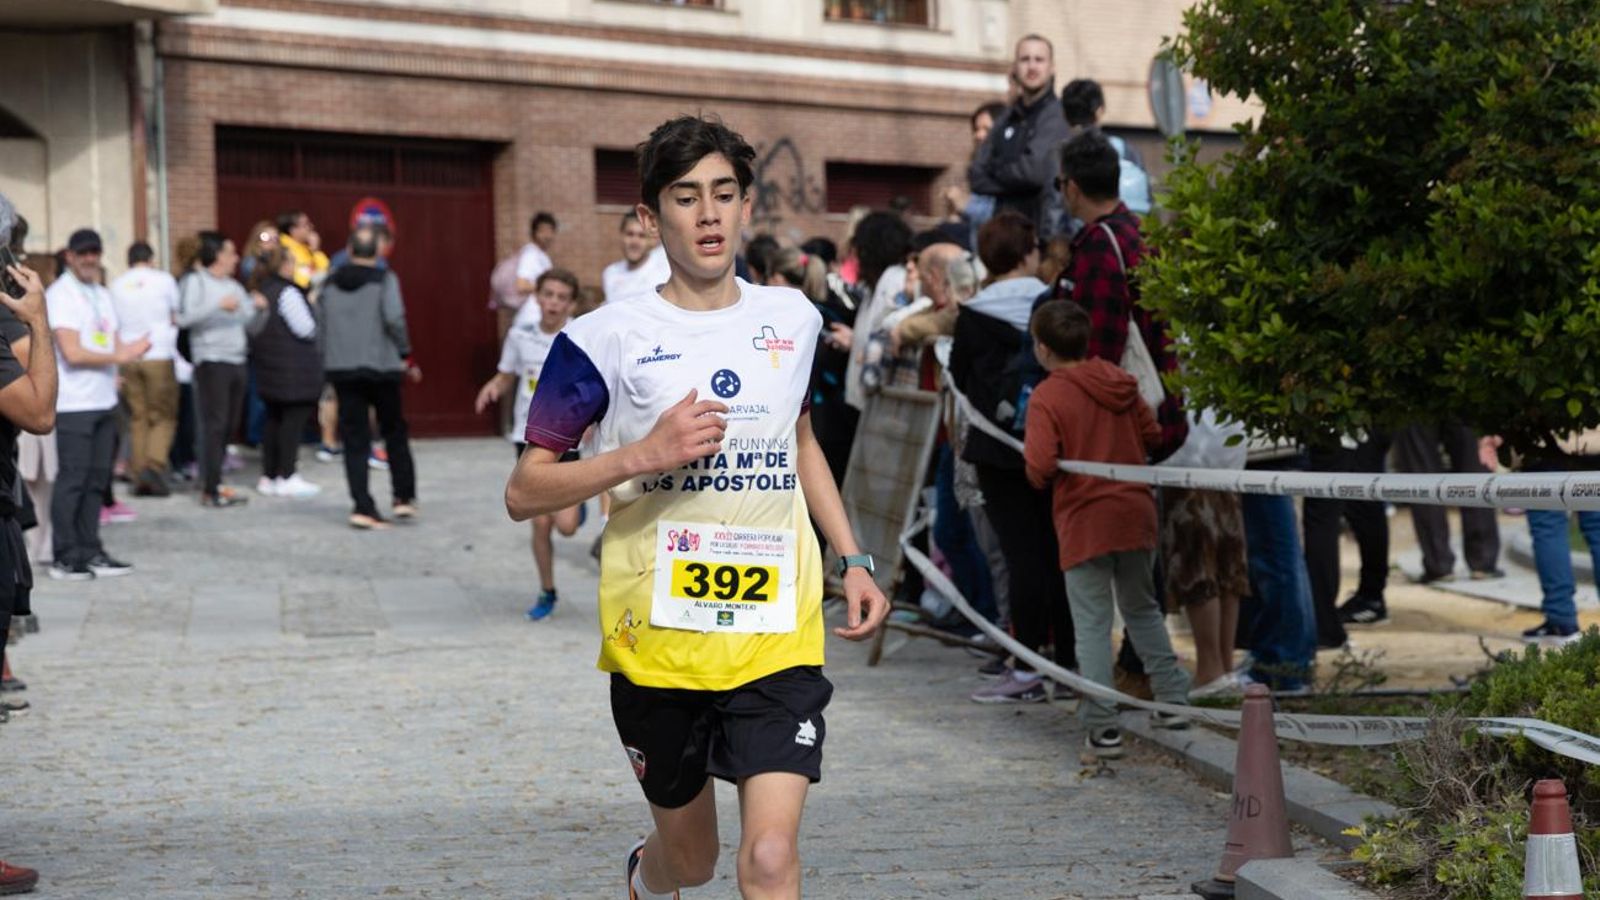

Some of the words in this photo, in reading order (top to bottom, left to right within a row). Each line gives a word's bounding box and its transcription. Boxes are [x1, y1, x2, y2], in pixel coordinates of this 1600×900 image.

[636, 353, 682, 365] TEAMERGY
[729, 404, 770, 414] ARVAJAL
[765, 452, 788, 468] DE
[682, 471, 796, 491] APÓSTOLES
[683, 562, 770, 602] 392
